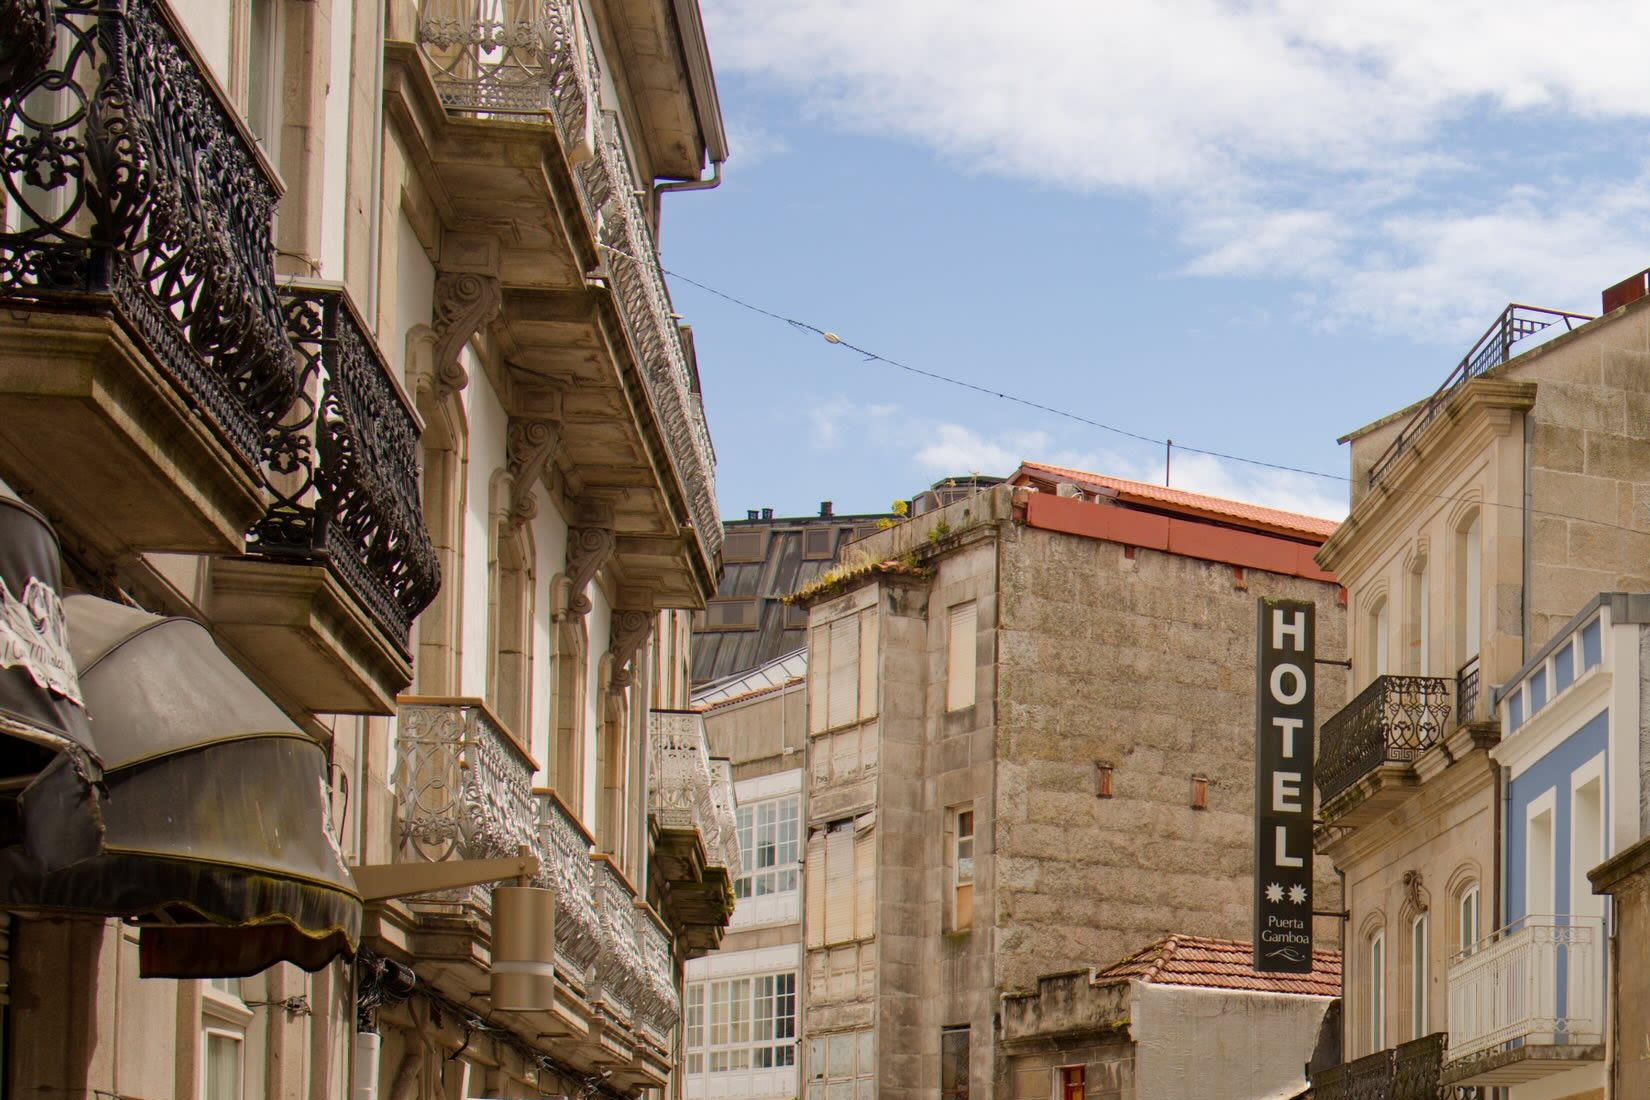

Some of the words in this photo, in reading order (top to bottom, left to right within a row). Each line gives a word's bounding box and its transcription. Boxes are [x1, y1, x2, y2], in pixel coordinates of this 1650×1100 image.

[1269, 609, 1307, 868] HOTEL
[1268, 915, 1304, 929] Puerta
[1262, 930, 1309, 944] Gamboa
